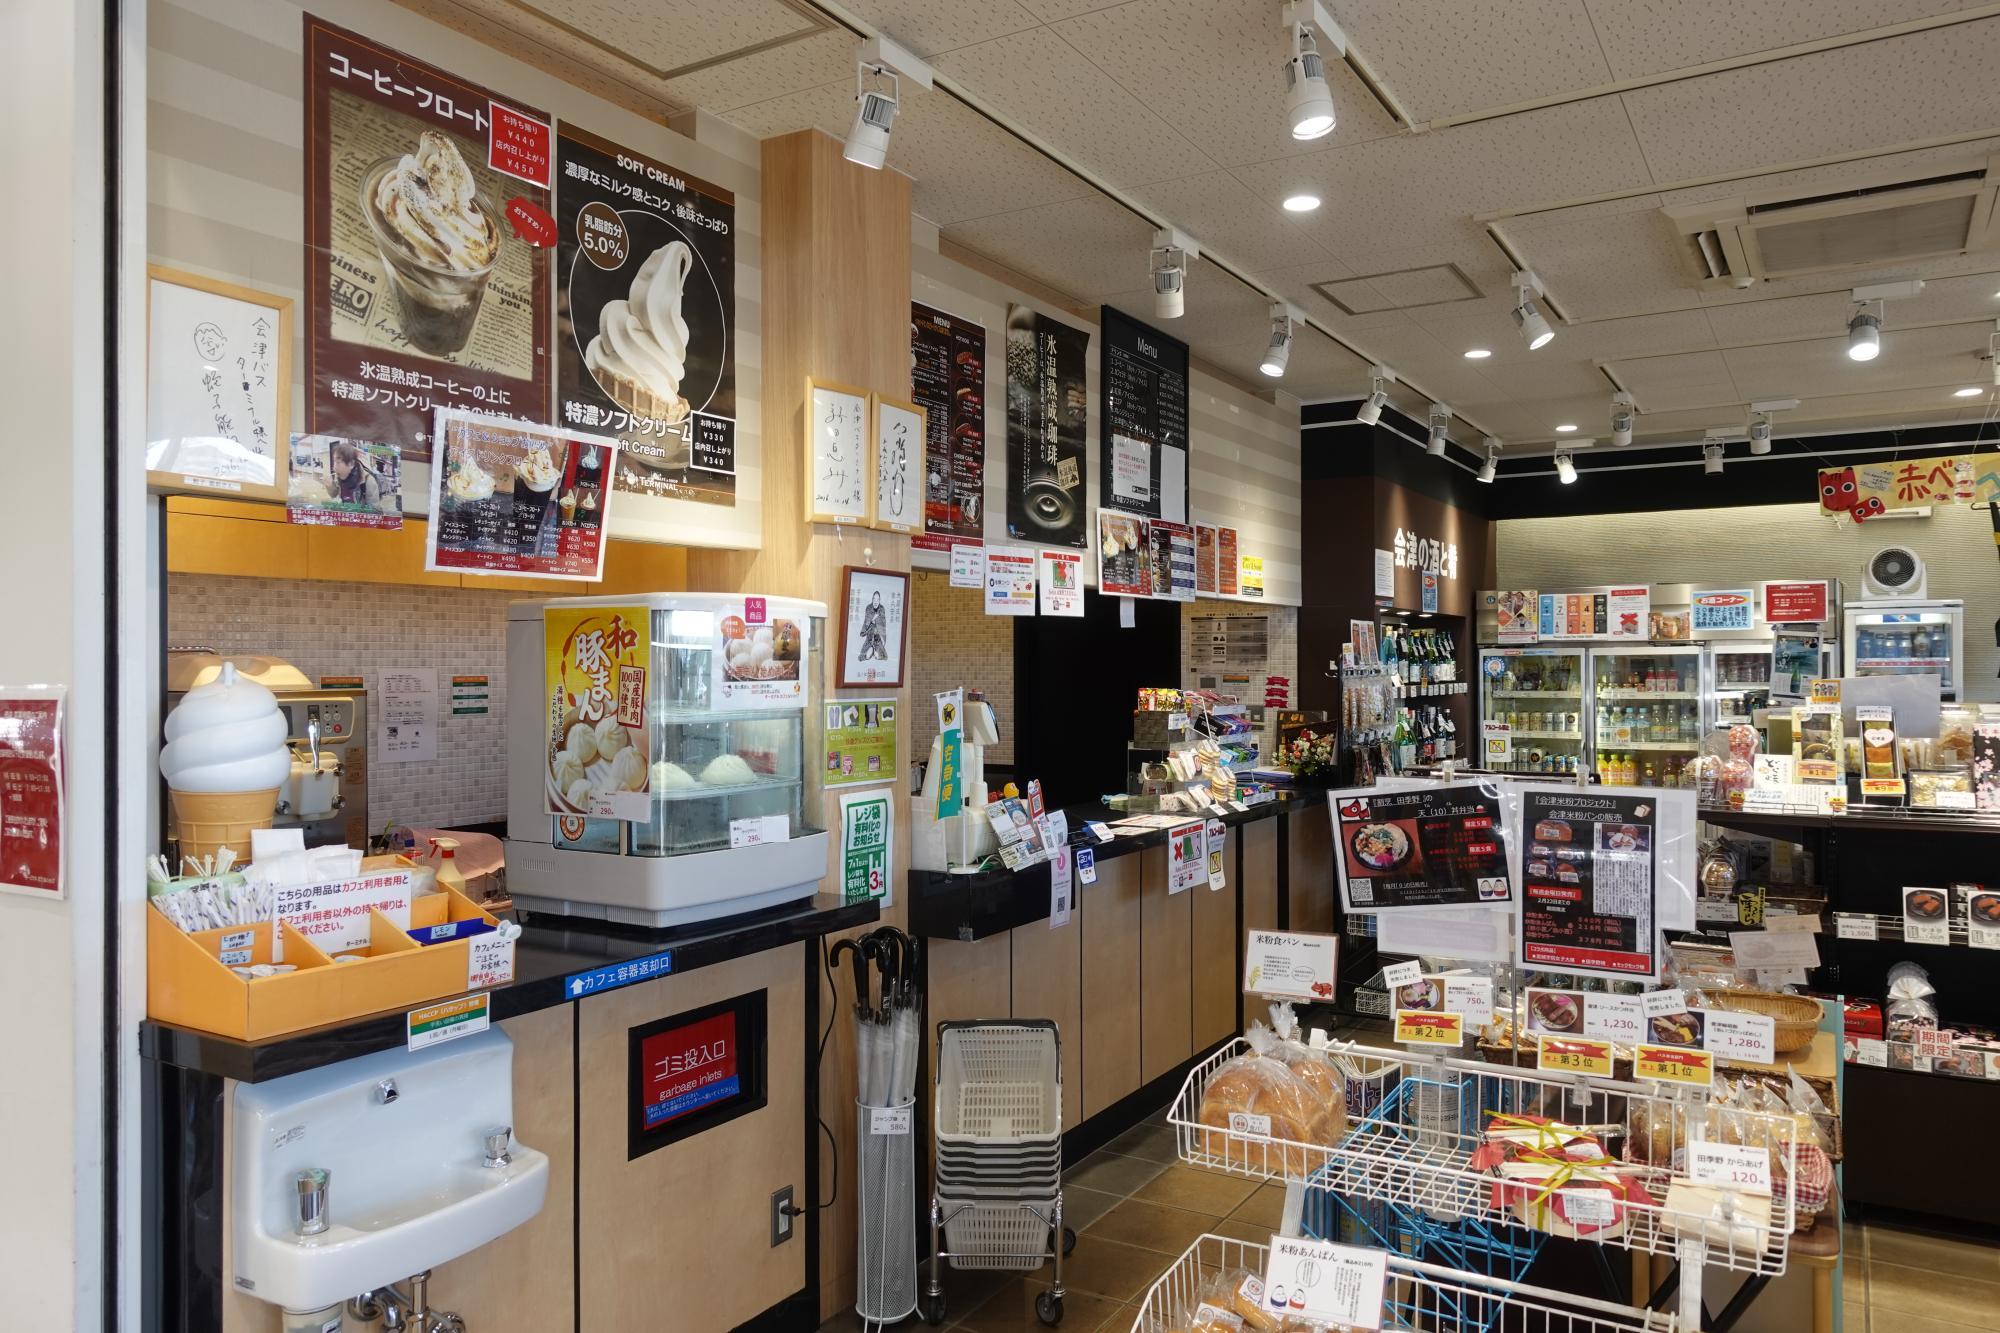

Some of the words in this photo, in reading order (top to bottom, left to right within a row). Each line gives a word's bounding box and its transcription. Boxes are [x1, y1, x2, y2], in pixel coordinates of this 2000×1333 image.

[328, 52, 489, 131] コーヒーフロート
[502, 114, 539, 135] お持ち帰り
[495, 140, 546, 165] 店内召し上がり
[616, 154, 645, 176] SOFT
[646, 167, 686, 193] CREAM
[565, 160, 730, 235] 濃厚なミルク感とコク、後味さっぱり
[584, 214, 623, 238] 乳脂肪分
[584, 232, 624, 259] 5.0%
[488, 281, 533, 306] thinkin
[1137, 336, 1158, 359] Menu
[360, 361, 512, 405] 氷温熟成コーヒーの上に
[1046, 333, 1059, 467] 氷温熟成珈琲
[632, 441, 666, 459] Cream
[606, 613, 639, 660] 和
[574, 629, 613, 722] 豚まん
[619, 671, 633, 717] 100%使用
[630, 670, 642, 724] 国産豚肉
[856, 804, 881, 823] レジ袋
[1549, 810, 1622, 822] 会津米粉パンの販売
[853, 832, 881, 847] お知らせ
[854, 820, 881, 836] 有料化の
[277, 875, 409, 902] こちらの用品はカフェ利用者用と
[848, 877, 866, 890] 有料化
[277, 900, 317, 915] なります。
[474, 941, 512, 953] カフェメニュー
[1256, 933, 1301, 946] 米粉食パン
[584, 956, 670, 990] カフェ容器返却口
[1415, 1026, 1445, 1039] 第2位
[1921, 1030, 1950, 1044] 期間
[655, 1040, 725, 1080] ゴミ投入口
[1560, 1053, 1594, 1068] 第3位
[1921, 1043, 1950, 1057] 限定
[1657, 1062, 1693, 1077] 第1位
[659, 1080, 698, 1101] garbage
[699, 1070, 722, 1086] inlets
[1697, 1154, 1724, 1165] 田季野
[1727, 1158, 1763, 1169] からあげ
[1280, 1243, 1338, 1263] 米粉あんぱん
